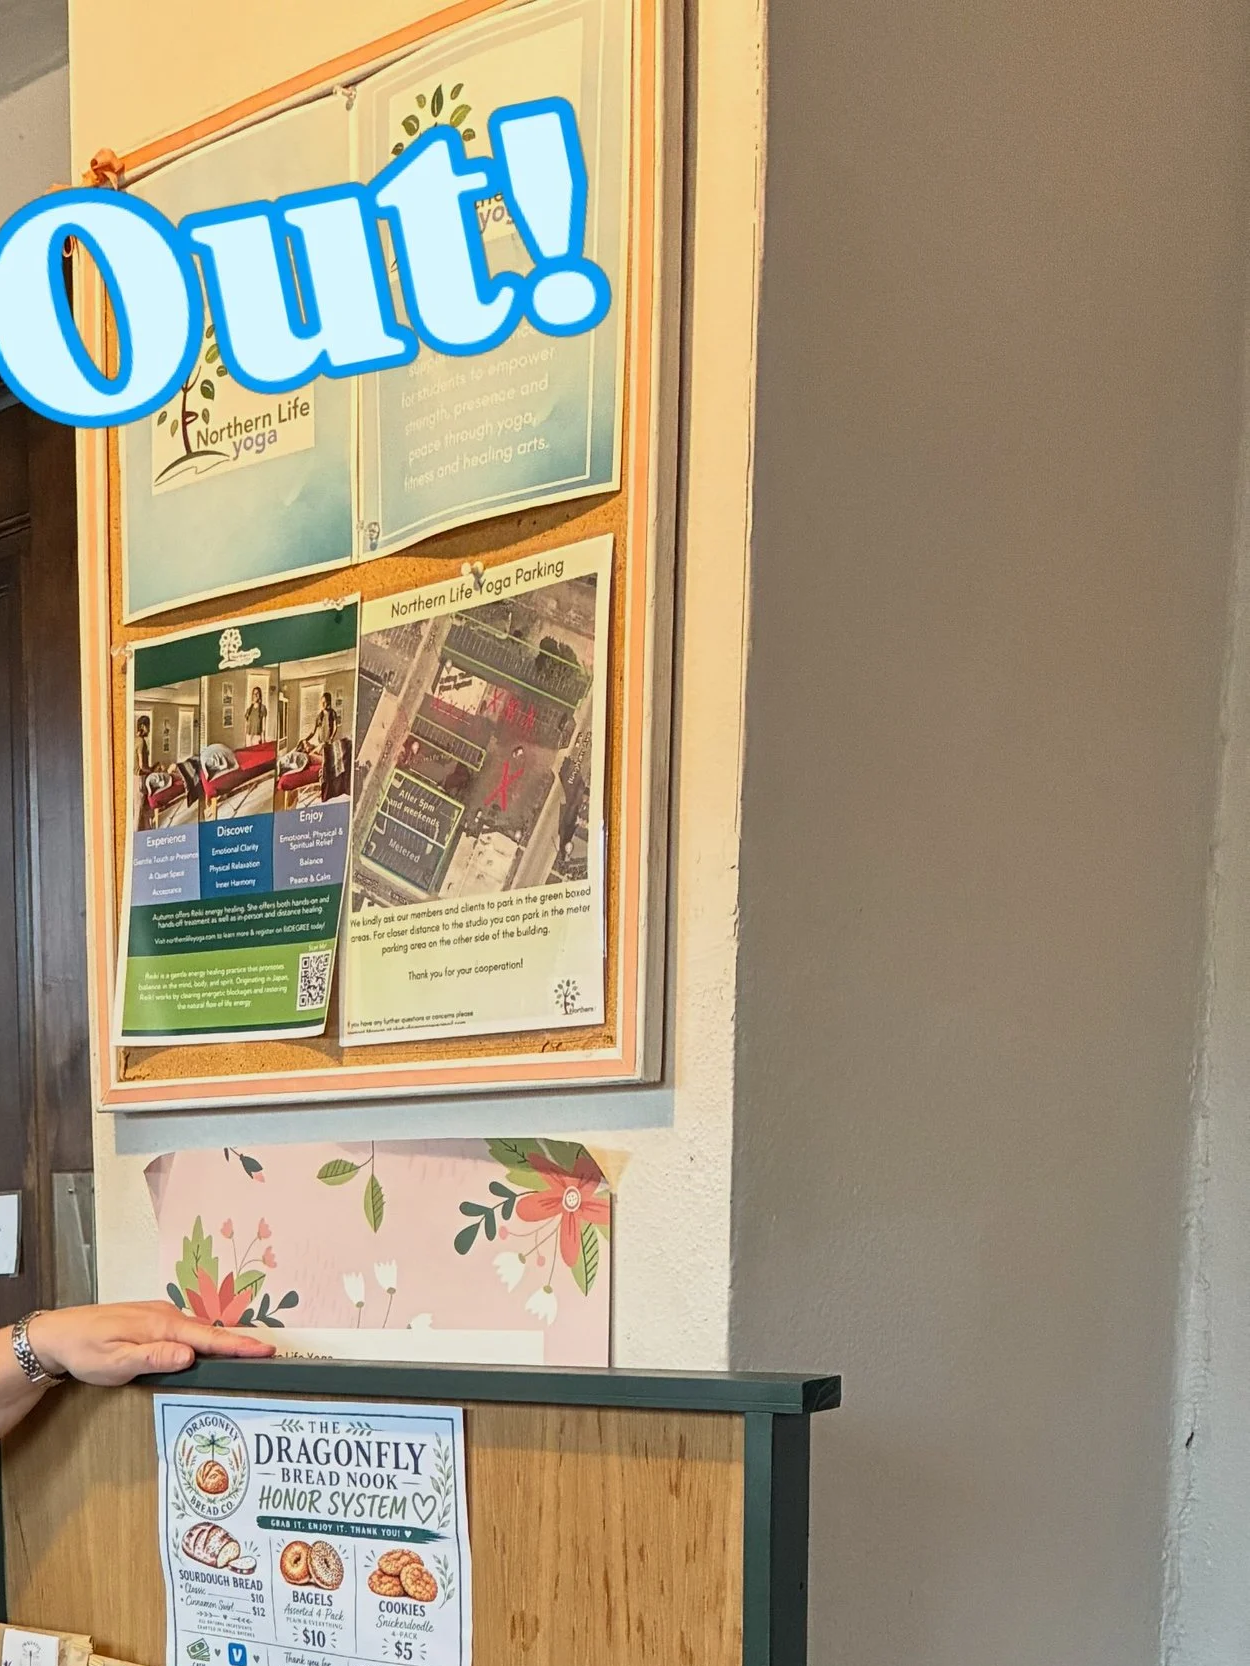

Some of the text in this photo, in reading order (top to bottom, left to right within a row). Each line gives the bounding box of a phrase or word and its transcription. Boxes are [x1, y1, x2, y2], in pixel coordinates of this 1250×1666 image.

[197, 397, 310, 449] Northern Life
[445, 419, 492, 445] through
[232, 429, 277, 460] yoga
[437, 437, 548, 477] and healing arts.
[391, 560, 564, 618] Northern Life Yoga Parking
[404, 805, 440, 827] weekends
[419, 799, 435, 812] 5pm
[299, 810, 323, 823] Enjoy
[147, 834, 186, 848] Experience
[217, 824, 253, 837] Discover
[212, 844, 259, 856] Emotional Clarity
[389, 838, 420, 863] Metered
[209, 863, 230, 874] Physical
[350, 885, 591, 928] We kindly ask our members and clients to park in the green boxed
[373, 931, 385, 940] For
[387, 929, 408, 938] closer
[410, 925, 440, 935] distance
[442, 922, 450, 931] to
[451, 919, 463, 929] the
[466, 916, 488, 928] studio
[490, 916, 504, 927] you
[522, 909, 539, 923] park
[541, 909, 549, 918] in
[551, 906, 564, 916] the
[566, 904, 590, 915] meter
[381, 925, 550, 956] parking area on the other side of the building.
[408, 958, 523, 981] Thank you for your cooperation!
[185, 1416, 239, 1441] DRAGONFLY
[308, 1421, 340, 1434] THE
[254, 1433, 427, 1475] DRAGONFLY
[281, 1468, 398, 1490] BREAD NOOK
[190, 1495, 235, 1516] BREAD CO.
[259, 1485, 406, 1520] HONOR SYSTEM
[271, 1519, 400, 1538] GRAB IT. ENJOY IT. THANK YOU!
[179, 1569, 263, 1591] SOURDOUGH BREAD
[185, 1582, 264, 1603] Classic $10
[292, 1590, 333, 1607] BAGELS
[186, 1595, 217, 1609] Cinnamon
[253, 1606, 266, 1617] $12
[284, 1604, 313, 1617] Assorted
[379, 1600, 425, 1618] COOKIES
[376, 1614, 434, 1633] Snickerdoodle
[302, 1627, 326, 1648] $10
[284, 1652, 305, 1665] Thank
[395, 1641, 413, 1661] $5
